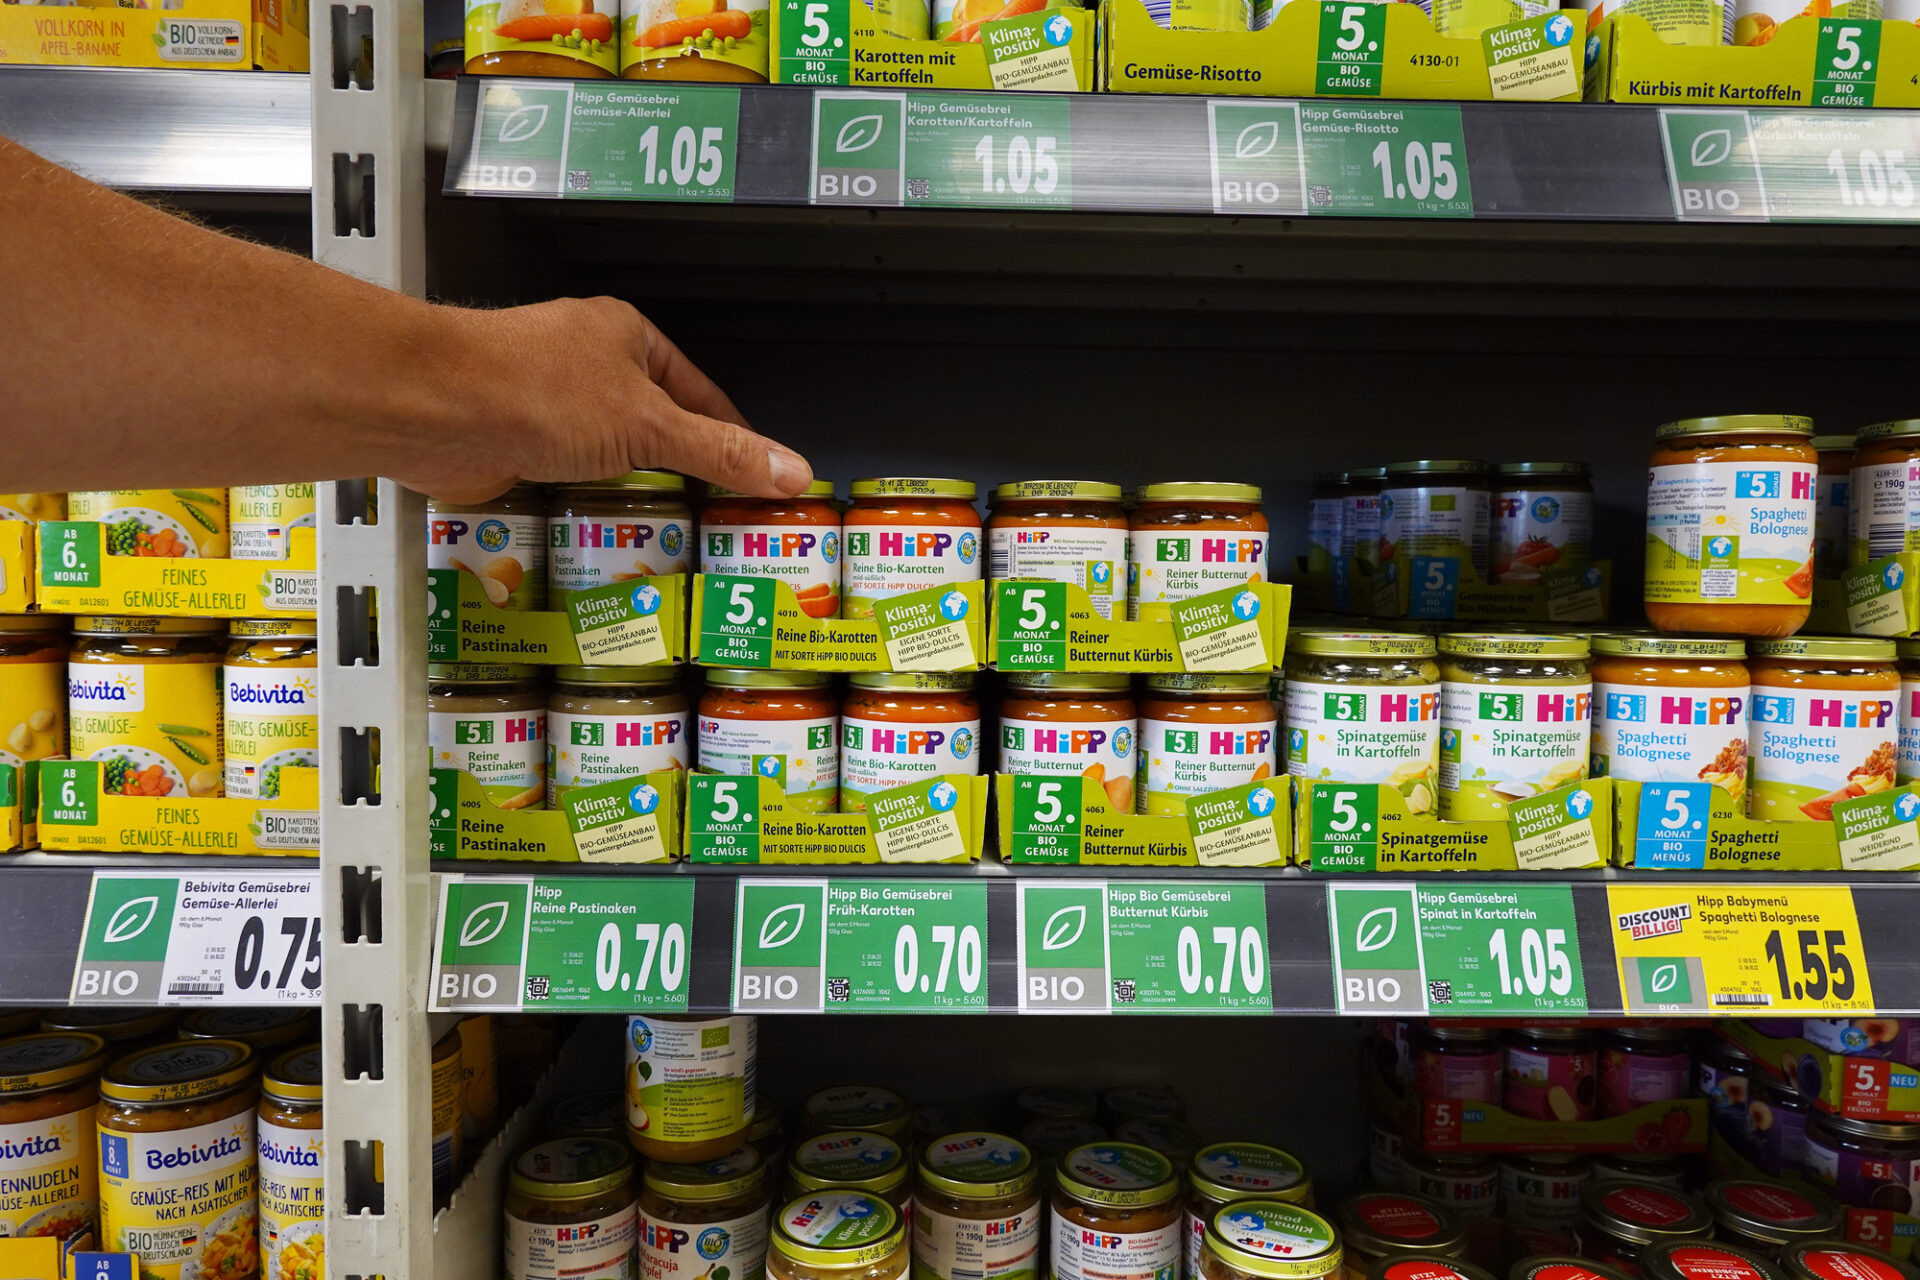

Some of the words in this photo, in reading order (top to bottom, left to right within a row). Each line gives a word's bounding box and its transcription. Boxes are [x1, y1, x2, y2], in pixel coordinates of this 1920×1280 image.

[34, 19, 104, 38] VOLLKORN
[111, 20, 125, 38] IN
[801, 3, 843, 47] 5.
[170, 25, 196, 45] BIO
[854, 29, 874, 37] 4110
[989, 25, 1037, 45] Klima-
[40, 41, 122, 57] APFEL-BANANE
[796, 48, 833, 57] MONAT
[993, 37, 1040, 60] positiv
[1832, 27, 1872, 70] 5.
[855, 49, 923, 64] Karotten
[929, 50, 955, 65] mit
[1331, 52, 1369, 62] MONAT
[1410, 55, 1459, 67] 4130-01
[805, 61, 826, 71] BIO
[995, 58, 1070, 82] BIO-GEMÜSEANBAU
[1124, 63, 1261, 82] Gemüse-Risotto
[1339, 65, 1360, 76] BIO
[793, 72, 838, 83] GEMÜSE
[855, 68, 933, 83] Kartoffeln
[1326, 76, 1371, 89] GEMÜSE
[1827, 71, 1863, 80] MONAT
[1629, 81, 1682, 97] Kürbis
[1687, 84, 1714, 98] mit
[1720, 84, 1801, 101] Kartoffeln
[1835, 84, 1854, 94] BIO
[575, 92, 603, 104] Hipp
[607, 92, 680, 104] Gemüsebrei
[574, 106, 671, 118] Gemüse-Allerlei
[908, 101, 935, 114] Hipp
[940, 102, 1011, 113] Gemüsebrei
[908, 115, 1032, 128] Karotten/Kartoffeln
[1301, 110, 1329, 122] Hipp
[1332, 110, 1403, 121] Gemüsebrei
[1303, 122, 1399, 134] Gemüse-Risotto
[639, 125, 723, 186] 1.05
[975, 135, 1058, 195] 1.05
[1372, 142, 1457, 200] 1.05
[481, 165, 537, 188] BIO
[1827, 148, 1914, 206] 1.05
[820, 175, 876, 196] BIO
[1222, 182, 1280, 203] BIO
[1683, 188, 1740, 210] BIO
[1751, 508, 1806, 521] Spaghetti
[579, 523, 654, 548] HiPP
[1750, 523, 1808, 536] Bolognese
[744, 533, 816, 557] HiPP
[880, 533, 951, 556] HiPP
[1202, 539, 1262, 563] HiPP
[62, 541, 86, 568] 6.
[54, 571, 90, 582] MONAT
[853, 564, 874, 574] Reine
[877, 564, 944, 574] Bio-Karotten
[1167, 568, 1198, 579] Reiner
[1202, 568, 1247, 579] Butternut
[162, 569, 207, 586] FEINES
[1167, 579, 1199, 590] Kürbis
[123, 588, 246, 610] GEMÜSE-ALLERLEI
[461, 601, 481, 609] 4005
[778, 610, 797, 618] 4010
[1019, 589, 1060, 630] 5.
[1178, 603, 1225, 624] Klima-
[462, 620, 505, 633] Reine
[1183, 613, 1229, 639] positiv
[777, 629, 806, 642] Reine
[809, 629, 877, 644] Bio-Karotten
[899, 632, 926, 647] EIGENE
[928, 626, 951, 640] SORTE
[1070, 631, 1109, 644] Reiner
[462, 638, 547, 653] Pastinaken
[775, 651, 789, 659] MIT
[791, 651, 813, 660] SORTE
[835, 652, 848, 660] BIO
[849, 652, 876, 661] DULCIS
[1070, 649, 1131, 663] Butternut
[1134, 648, 1173, 663] Kürbis
[231, 682, 305, 704] Bebivita
[1661, 696, 1742, 724] HiPP
[872, 729, 945, 754] HiPP
[1034, 728, 1106, 753] HiPP
[1337, 730, 1427, 745] Spinatgemüse
[1617, 729, 1687, 746] Spaghetti
[581, 753, 609, 763] Reine
[1337, 745, 1352, 757] in
[1355, 745, 1420, 758] Kartoffeln
[1617, 744, 1691, 761] Bolognese
[581, 763, 639, 774] Pastinaken
[1175, 761, 1206, 771] Reiner
[1210, 761, 1256, 772] Butternut
[1175, 772, 1206, 782] Kürbis
[157, 808, 200, 824] FEINES
[1713, 811, 1732, 819] 6230
[266, 818, 286, 833] BIO
[462, 820, 504, 833] Reine
[763, 823, 793, 835] Reine
[796, 823, 866, 836] Bio-Karotten
[120, 828, 238, 848] GEMÜSE-ALLERLEI
[462, 838, 546, 853] Pastinaken
[1381, 832, 1488, 848] Spinatgemüse
[1711, 831, 1779, 846] Spaghetti
[1859, 836, 1901, 855] WEIDERIND
[1381, 849, 1397, 862] in
[1400, 849, 1477, 863] Kartoffeln
[1653, 851, 1690, 862] MENÜS
[1710, 847, 1780, 862] Bolognese
[184, 881, 235, 893] Bebivita
[238, 882, 311, 895] Gemüsebrei
[534, 886, 562, 898] Hipp
[830, 889, 856, 902] Hipp
[860, 889, 879, 900] Bio
[882, 889, 952, 900] Gemüsebrei
[182, 898, 277, 910] Gemüse-Allerlei
[533, 903, 565, 914] Reine
[569, 903, 636, 914] Pastinaken
[1697, 896, 1724, 909] Hipp
[1727, 896, 1788, 909] Babymenü
[829, 905, 915, 917] Früh-Karotten
[1110, 906, 1168, 918] Butternut
[1171, 905, 1208, 918] Kürbis
[1421, 909, 1458, 921] Spinat
[1461, 909, 1471, 920] in
[1475, 908, 1536, 920] Kartoffeln
[1619, 906, 1688, 928] DISCOUNT
[1700, 912, 1757, 926] Spaghetti
[1761, 912, 1820, 925] Bolognese
[1632, 920, 1680, 940] BILLIG!
[234, 915, 321, 990] 0.75
[596, 923, 685, 991] 0.70
[895, 925, 982, 993] 0.70
[1177, 926, 1264, 994] 0.70
[1488, 928, 1572, 995] 1.05
[1765, 930, 1855, 1000] 1.55
[79, 970, 139, 995] BIO
[440, 974, 497, 998] BIO
[1890, 1076, 1917, 1086] NEU
[146, 1136, 241, 1169] Bebivita
[130, 1185, 209, 1206] GEMÜSE-REIS
[214, 1178, 234, 1195] MIT
[156, 1208, 186, 1220] NACH
[190, 1190, 248, 1216] ASIATISCHER
[153, 1229, 197, 1239] HÜHNCHEN-
[1082, 1231, 1122, 1249] HiPP
